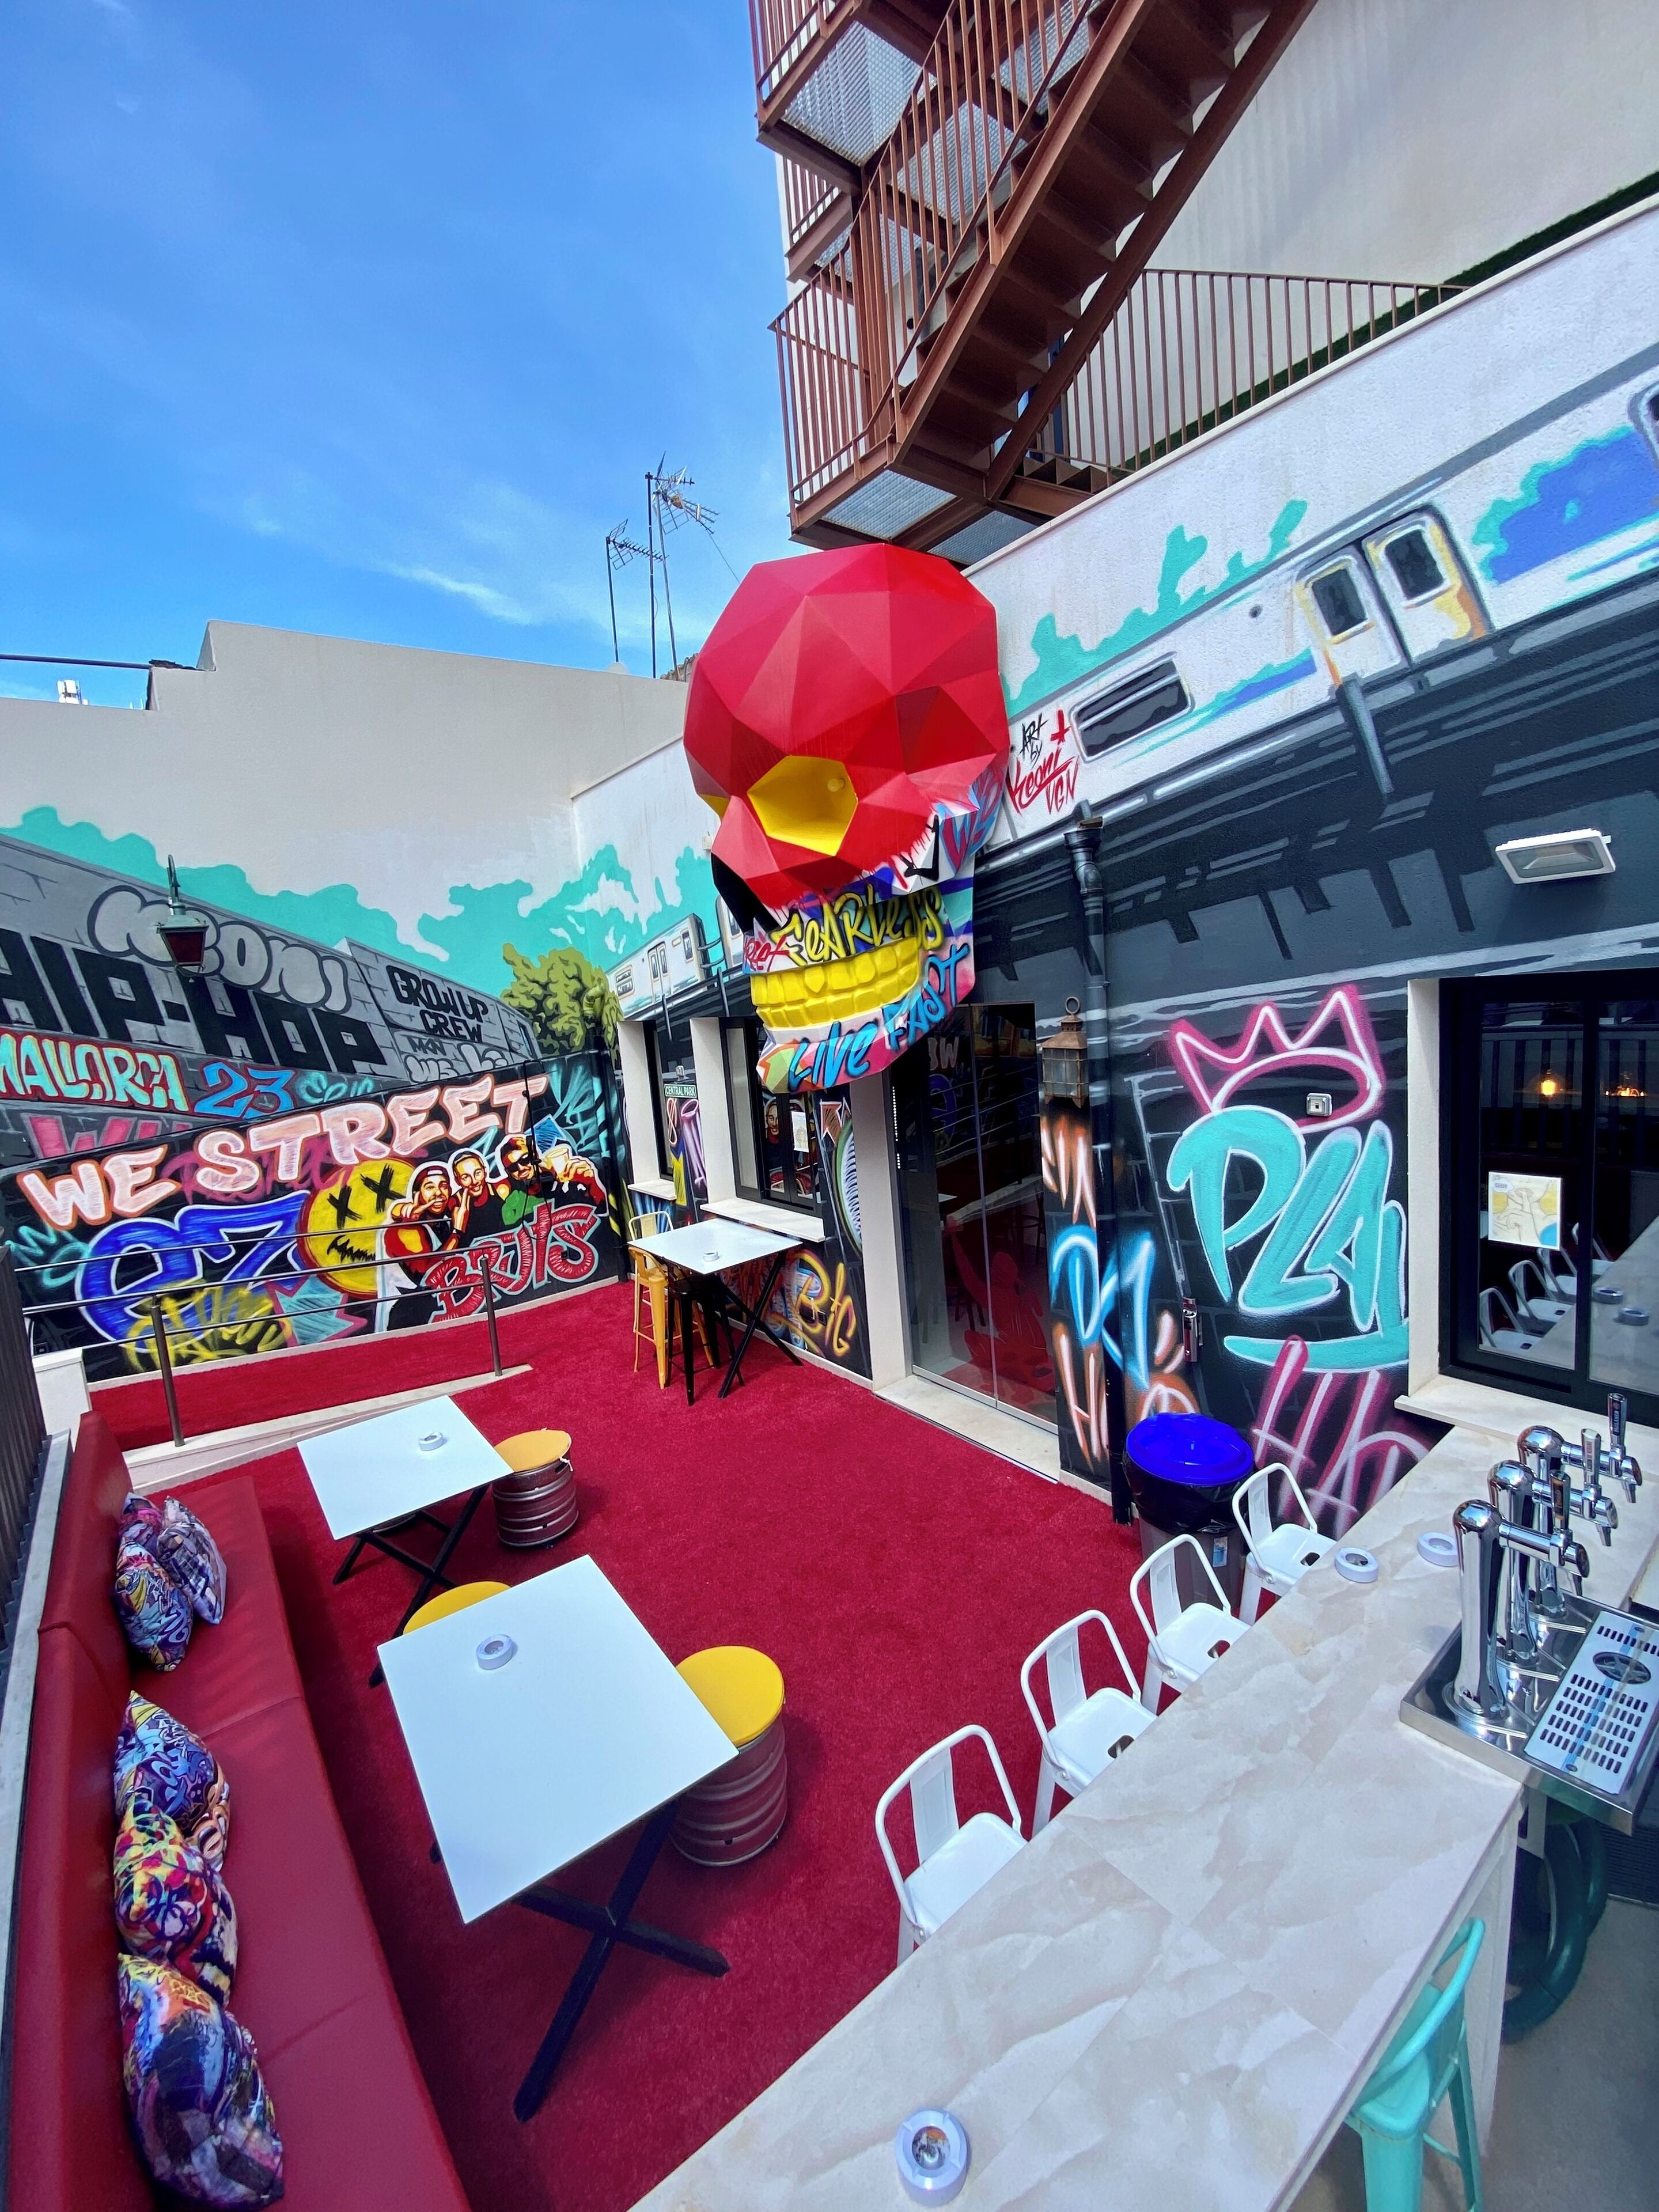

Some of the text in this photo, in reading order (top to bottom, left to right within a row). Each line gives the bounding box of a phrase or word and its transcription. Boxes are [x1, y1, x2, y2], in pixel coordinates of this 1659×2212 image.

[385, 965, 489, 1024] GROW UP
[419, 1009, 483, 1043] CREW
[191, 1059, 297, 1119] 23
[665, 1085, 696, 1097] CENTRAL PARK
[194, 1073, 551, 1193] STREET
[16, 1143, 182, 1232] WE
